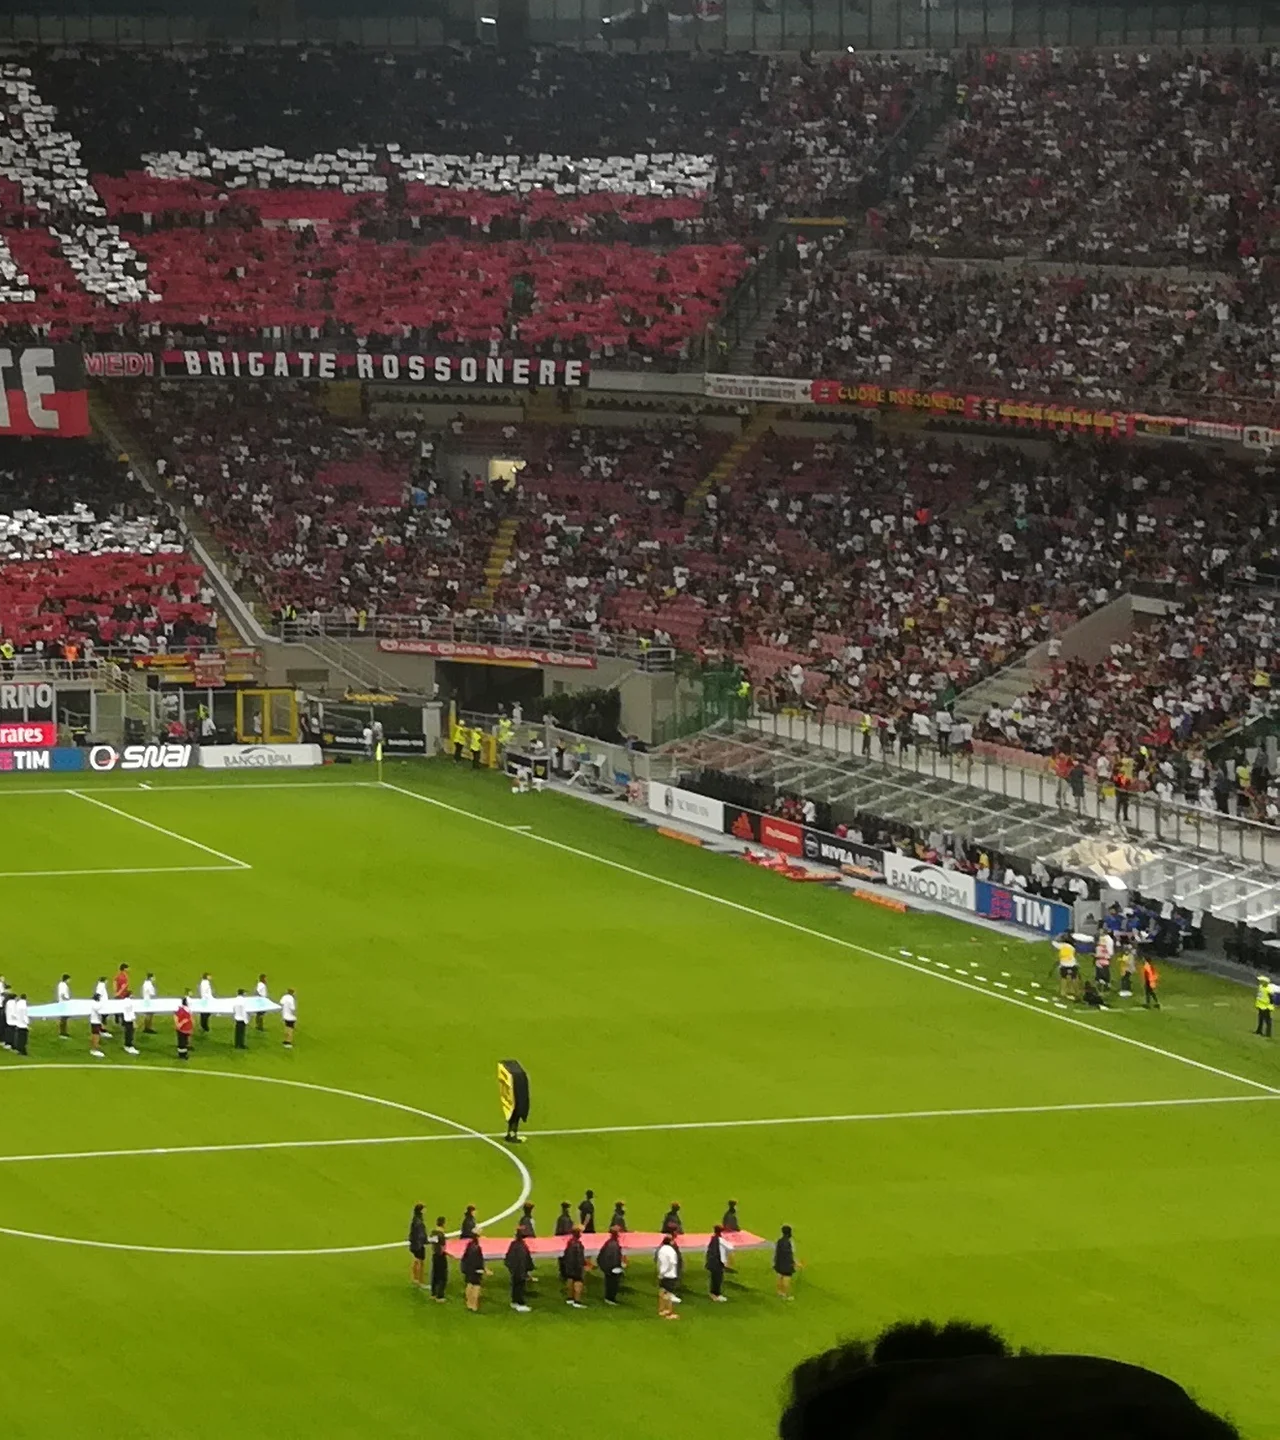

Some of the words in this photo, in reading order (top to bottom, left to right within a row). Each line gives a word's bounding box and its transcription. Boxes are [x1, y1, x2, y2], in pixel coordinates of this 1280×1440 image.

[184, 351, 336, 377] BRIGATE
[357, 354, 583, 385] ROSSONERE
[839, 387, 884, 404] CUORE
[889, 390, 966, 412] ROSSONERO
[14, 750, 50, 770] TIM
[223, 754, 266, 767] BANCO
[891, 869, 938, 898] BANCO
[940, 884, 968, 906] BPM
[1012, 894, 1052, 931] TIM
